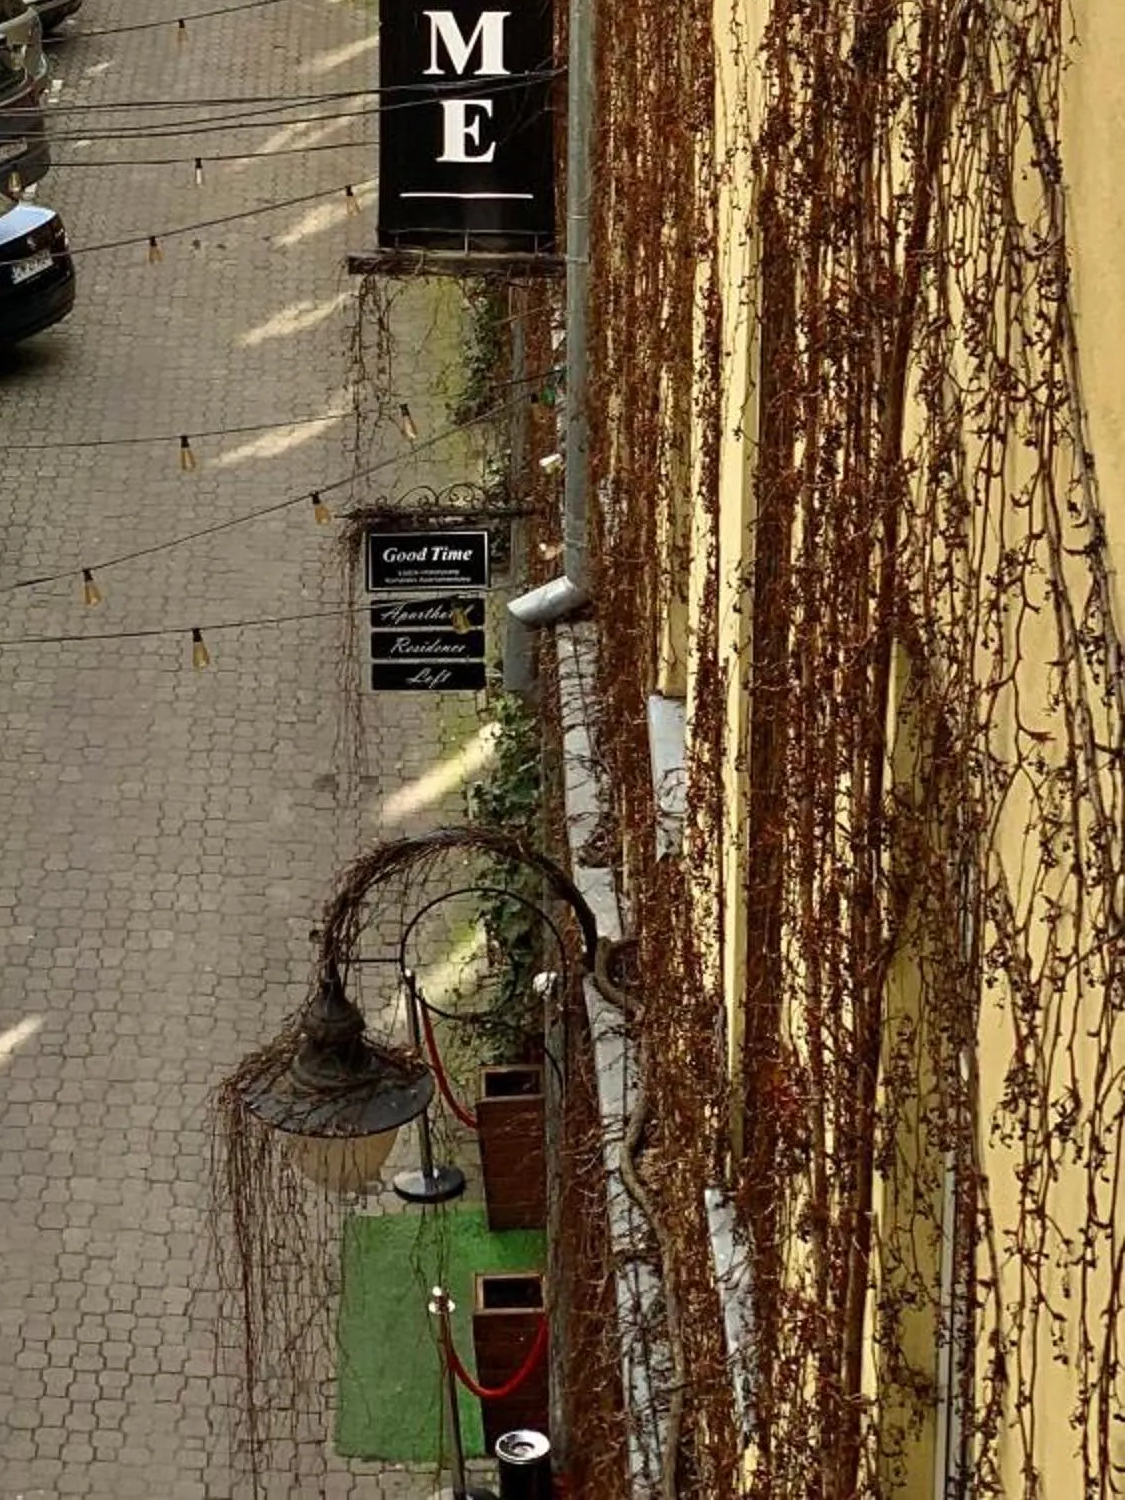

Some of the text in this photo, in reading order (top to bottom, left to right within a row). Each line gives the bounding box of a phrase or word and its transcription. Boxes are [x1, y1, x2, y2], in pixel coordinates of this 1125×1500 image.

[382, 545, 474, 563] Good Time
[405, 666, 453, 689] Loft
